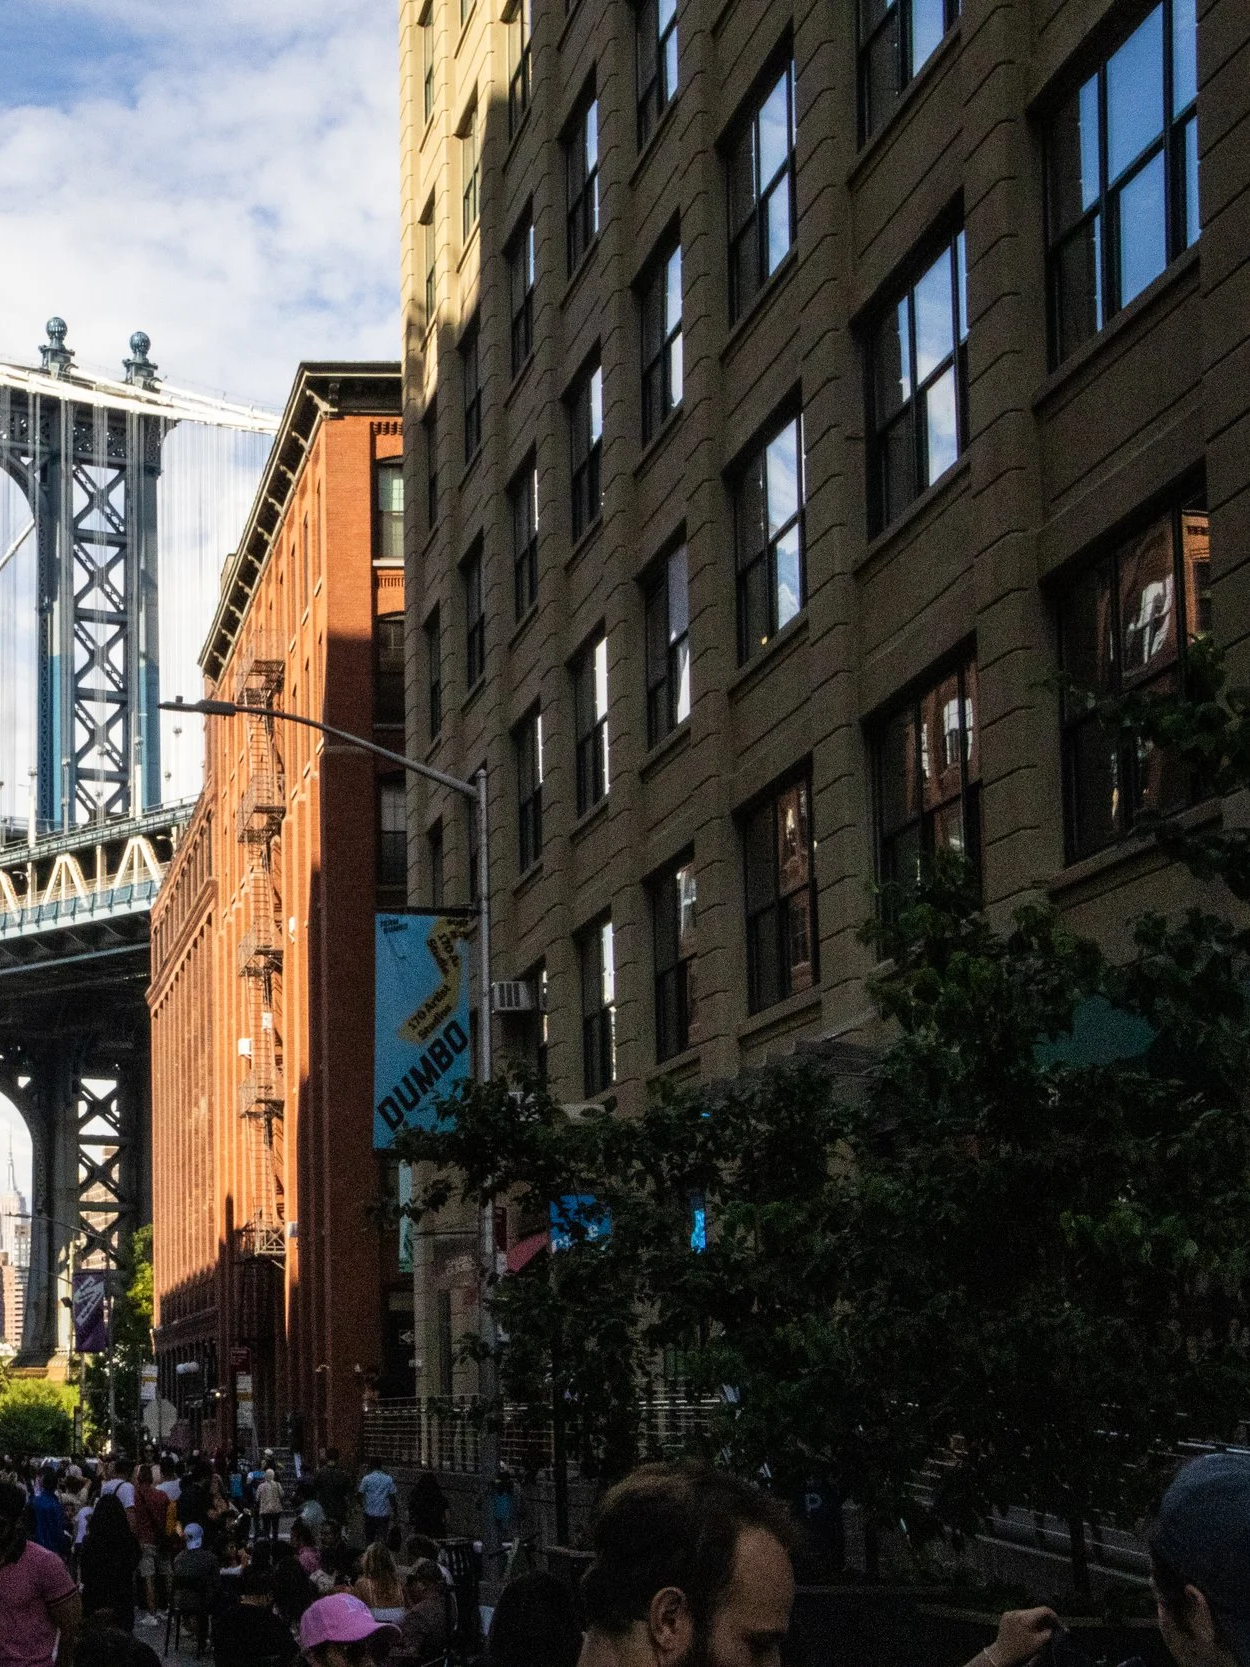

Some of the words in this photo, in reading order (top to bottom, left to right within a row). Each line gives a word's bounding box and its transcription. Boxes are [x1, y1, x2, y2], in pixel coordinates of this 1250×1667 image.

[408, 1009, 426, 1030] 170
[425, 984, 451, 1013] Artist
[378, 1020, 468, 1132] DUMBO
